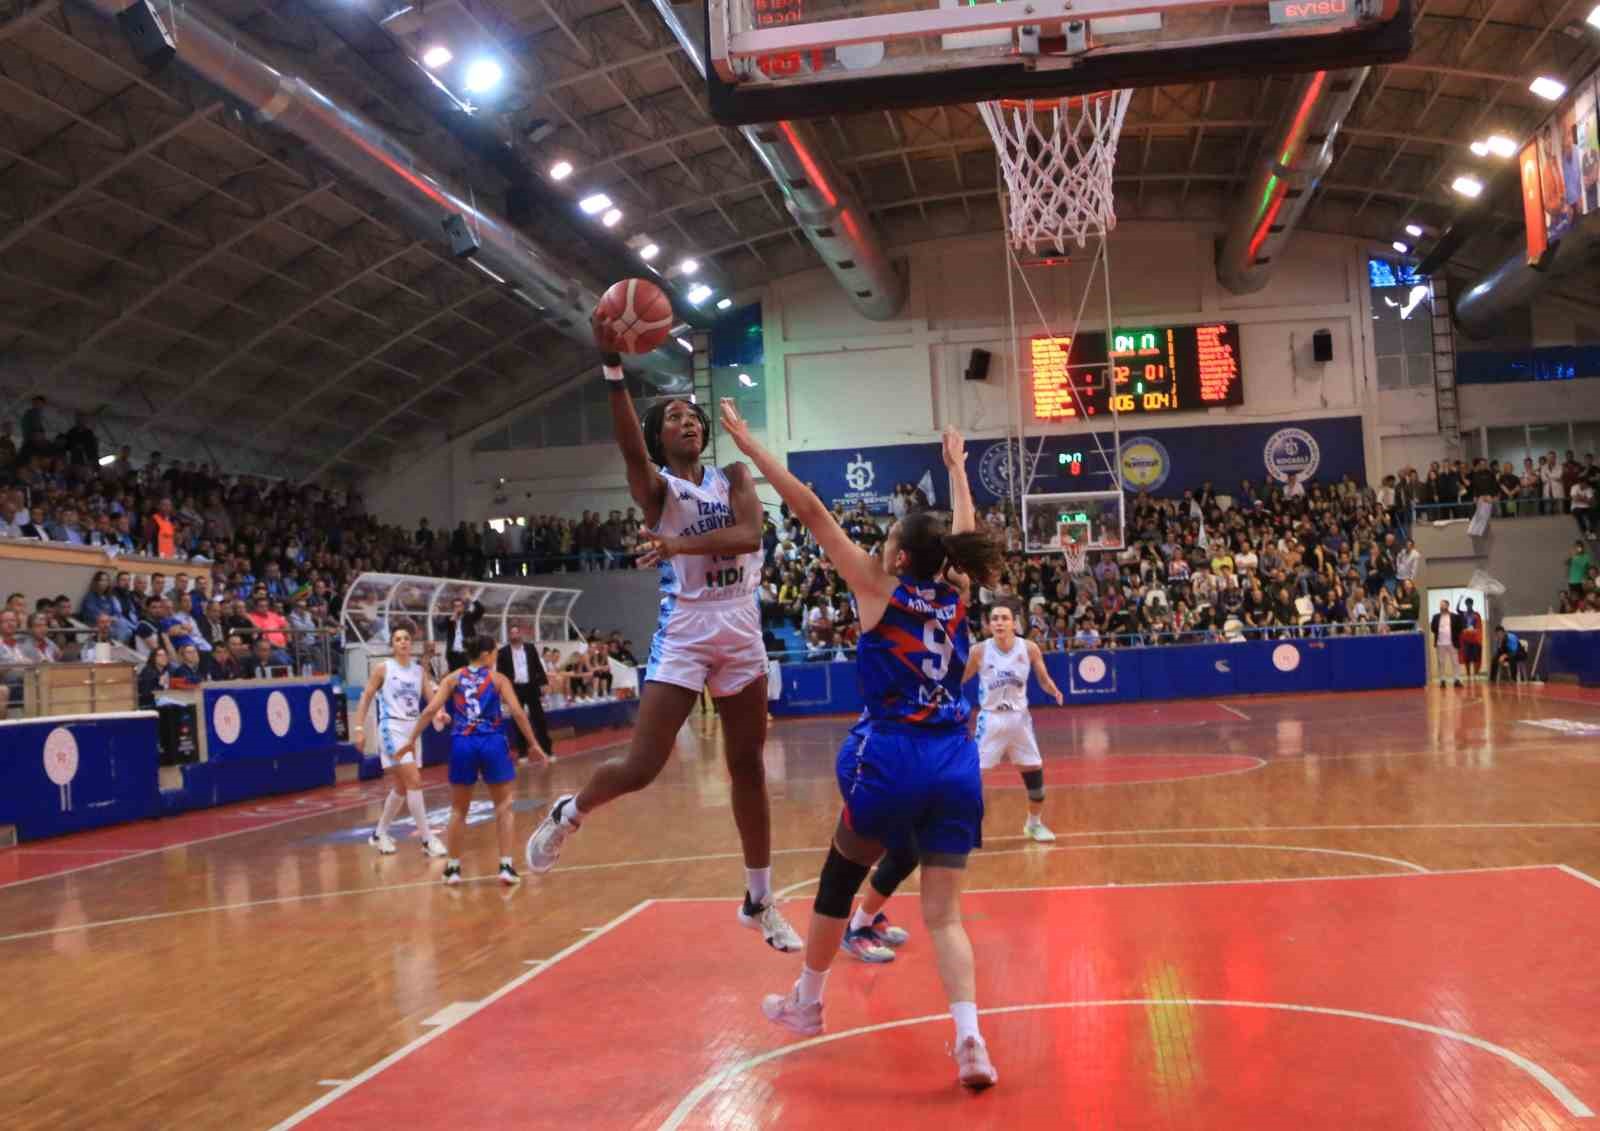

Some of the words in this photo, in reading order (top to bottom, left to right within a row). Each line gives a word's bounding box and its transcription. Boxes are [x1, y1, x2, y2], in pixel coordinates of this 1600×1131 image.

[1144, 363, 1165, 381] 01
[1143, 392, 1170, 410] 004
[705, 565, 744, 588] HDI
[922, 619, 954, 680] 9
